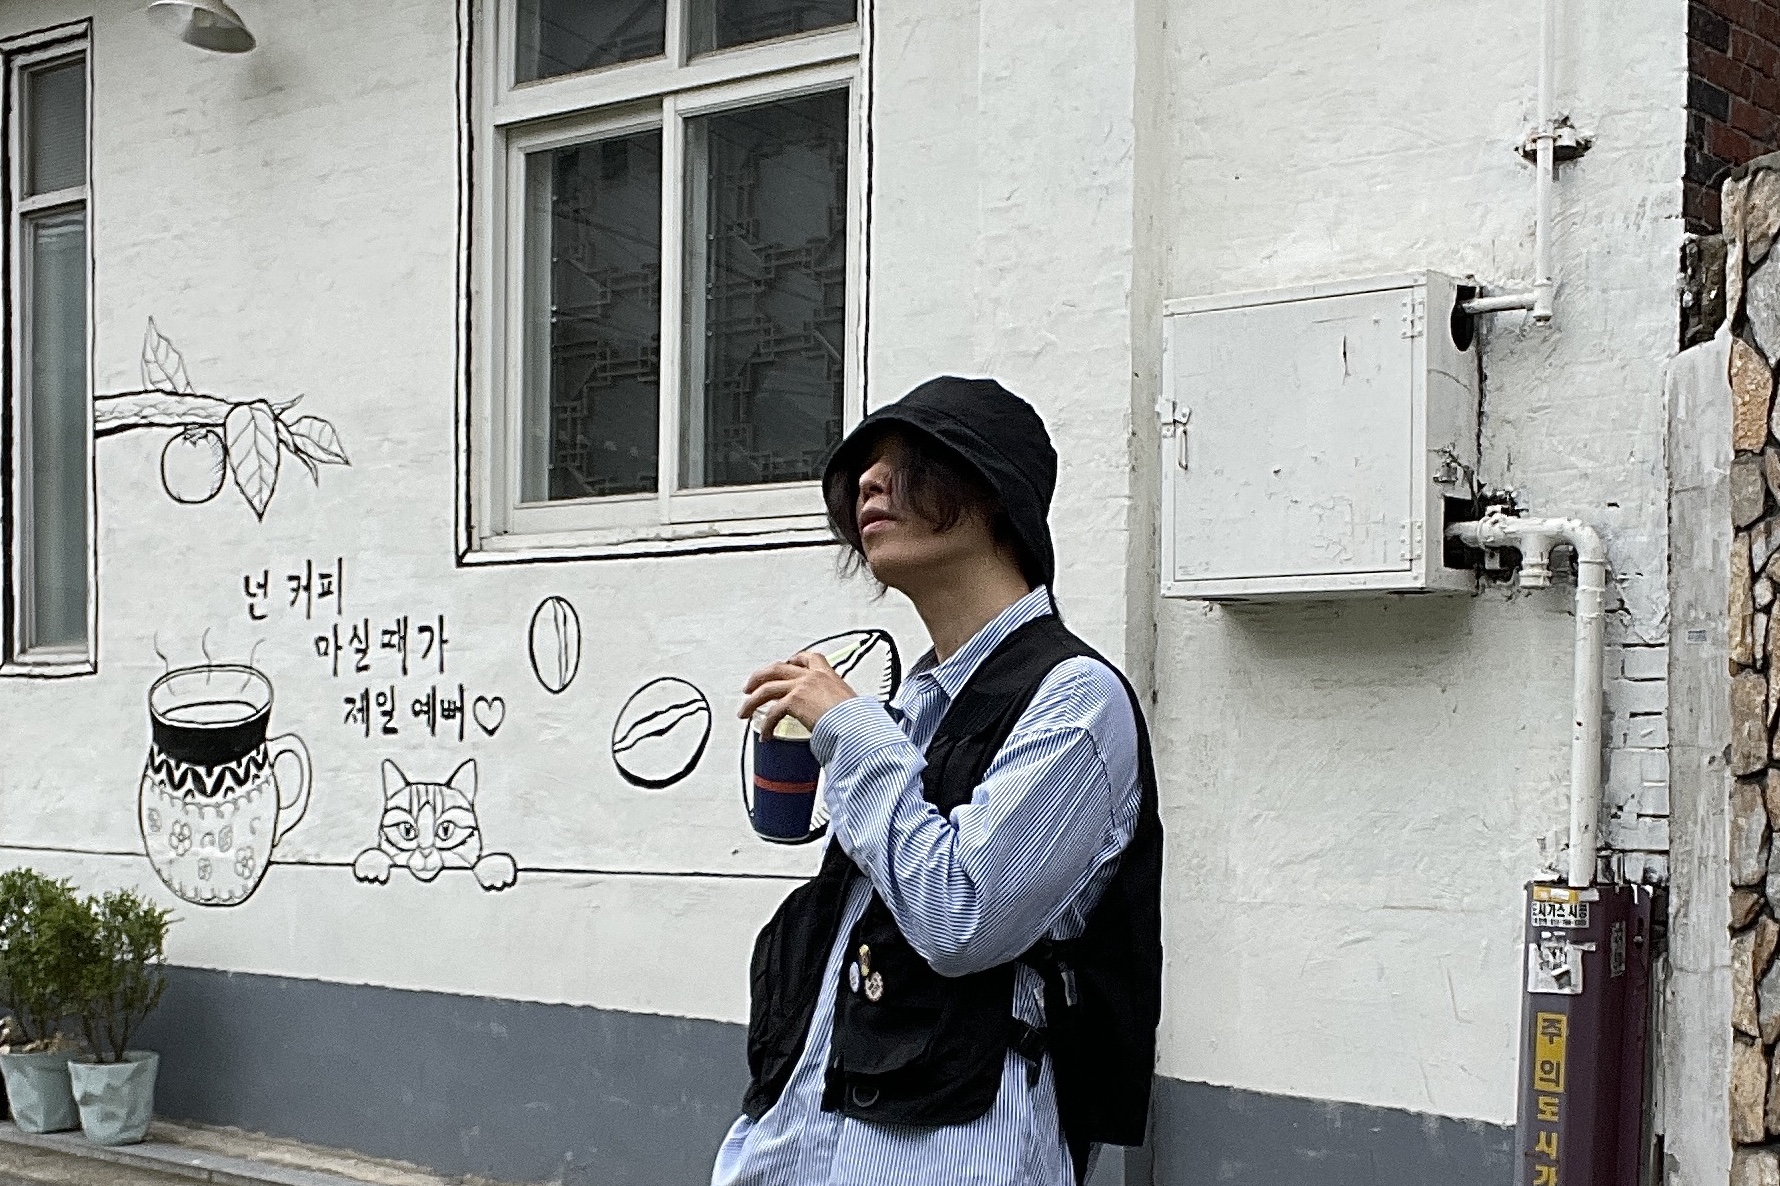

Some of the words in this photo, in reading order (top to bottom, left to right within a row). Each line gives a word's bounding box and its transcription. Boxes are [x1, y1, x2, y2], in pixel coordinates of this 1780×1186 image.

[243, 568, 270, 621] 넌
[286, 556, 344, 621] 커피
[343, 685, 400, 739] 제일
[411, 683, 466, 743] 예뻐
[1538, 1018, 1562, 1088] 주의
